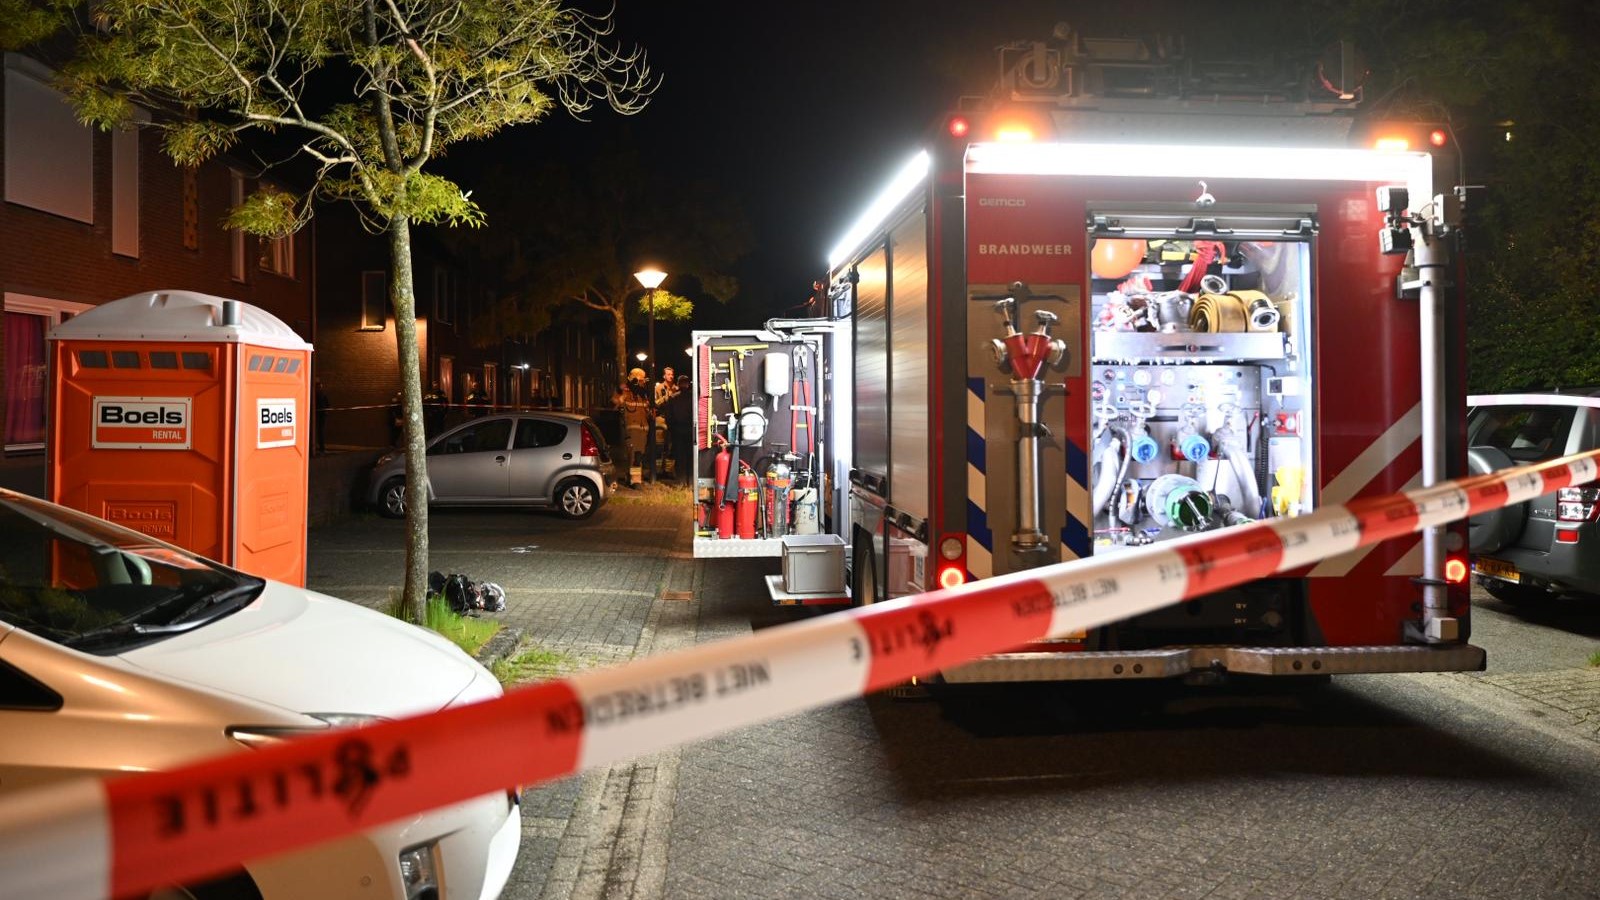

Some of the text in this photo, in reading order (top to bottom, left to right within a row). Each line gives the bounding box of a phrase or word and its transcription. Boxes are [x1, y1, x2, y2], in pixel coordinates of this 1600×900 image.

[978, 244, 1072, 255] BRANDWEER
[101, 405, 182, 424] Boels
[261, 407, 292, 424] Boels
[152, 430, 182, 440] RENTAL
[715, 659, 772, 696] NIET
